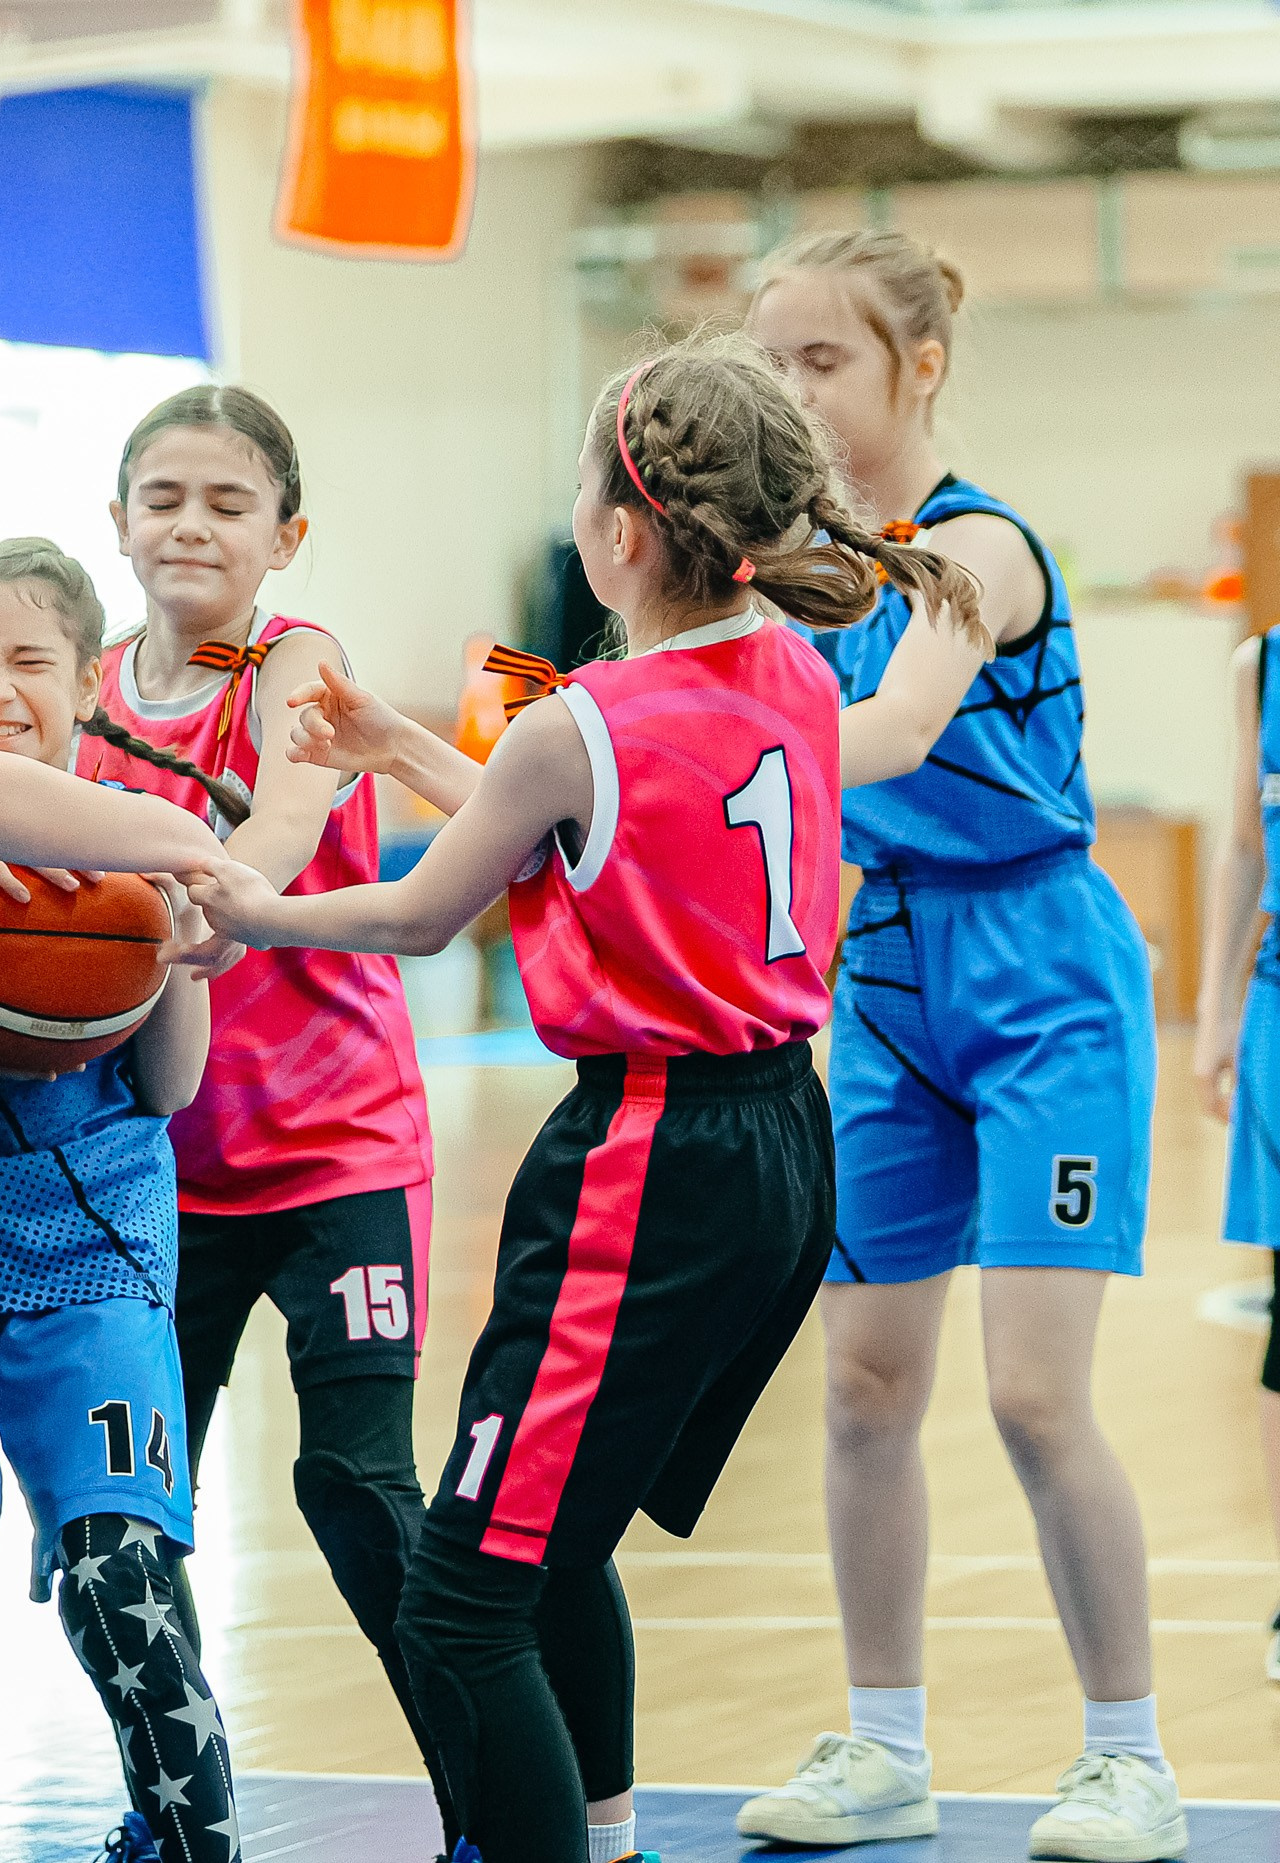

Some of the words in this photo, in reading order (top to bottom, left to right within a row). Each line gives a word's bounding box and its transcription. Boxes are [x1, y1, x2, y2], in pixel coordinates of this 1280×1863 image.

[722, 744, 807, 965] 1
[1048, 1153, 1099, 1231] 5
[329, 1263, 410, 1341] 15
[87, 1398, 175, 1500] 14
[454, 1412, 504, 1501] 1
